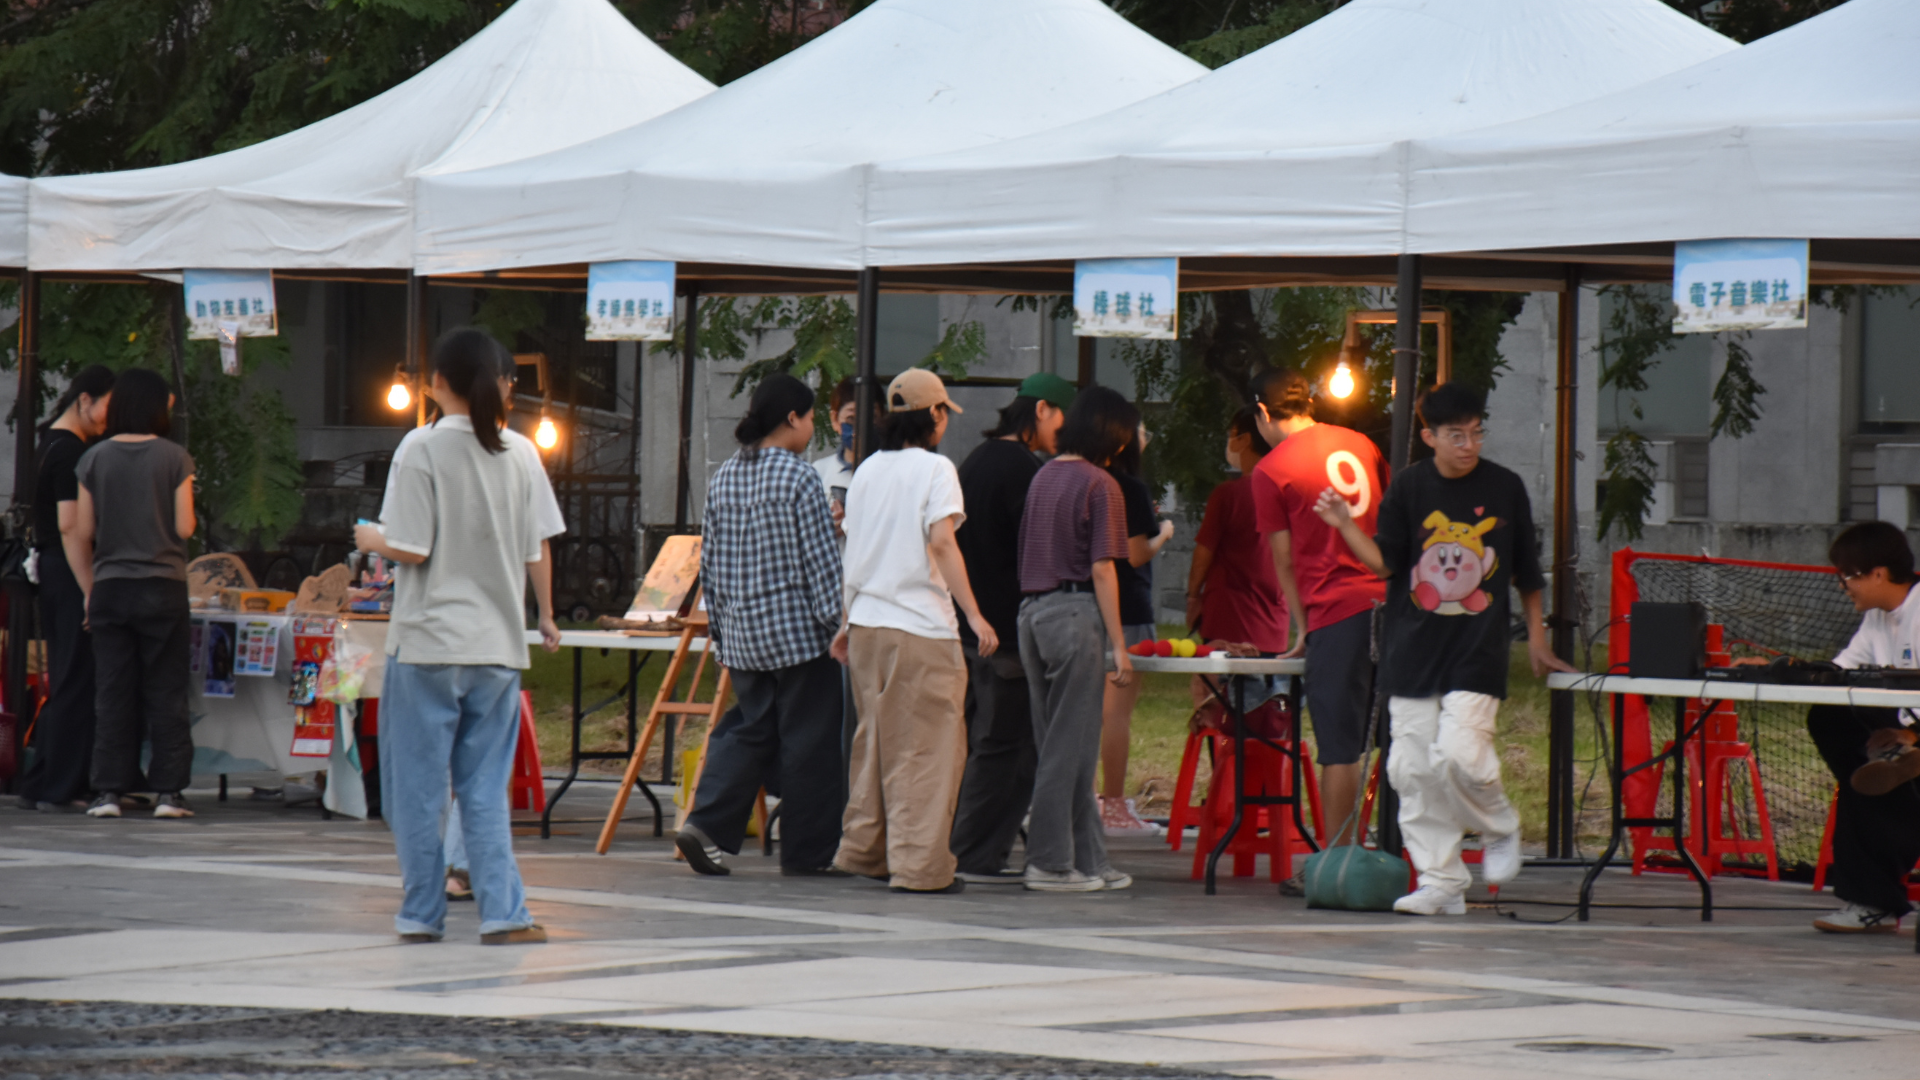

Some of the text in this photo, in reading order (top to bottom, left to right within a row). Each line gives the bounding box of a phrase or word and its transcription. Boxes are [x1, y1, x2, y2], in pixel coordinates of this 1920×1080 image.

[1093, 290, 1155, 316] 棒球社
[1689, 279, 1789, 308] 電子音樂社
[1326, 450, 1371, 518] 9
